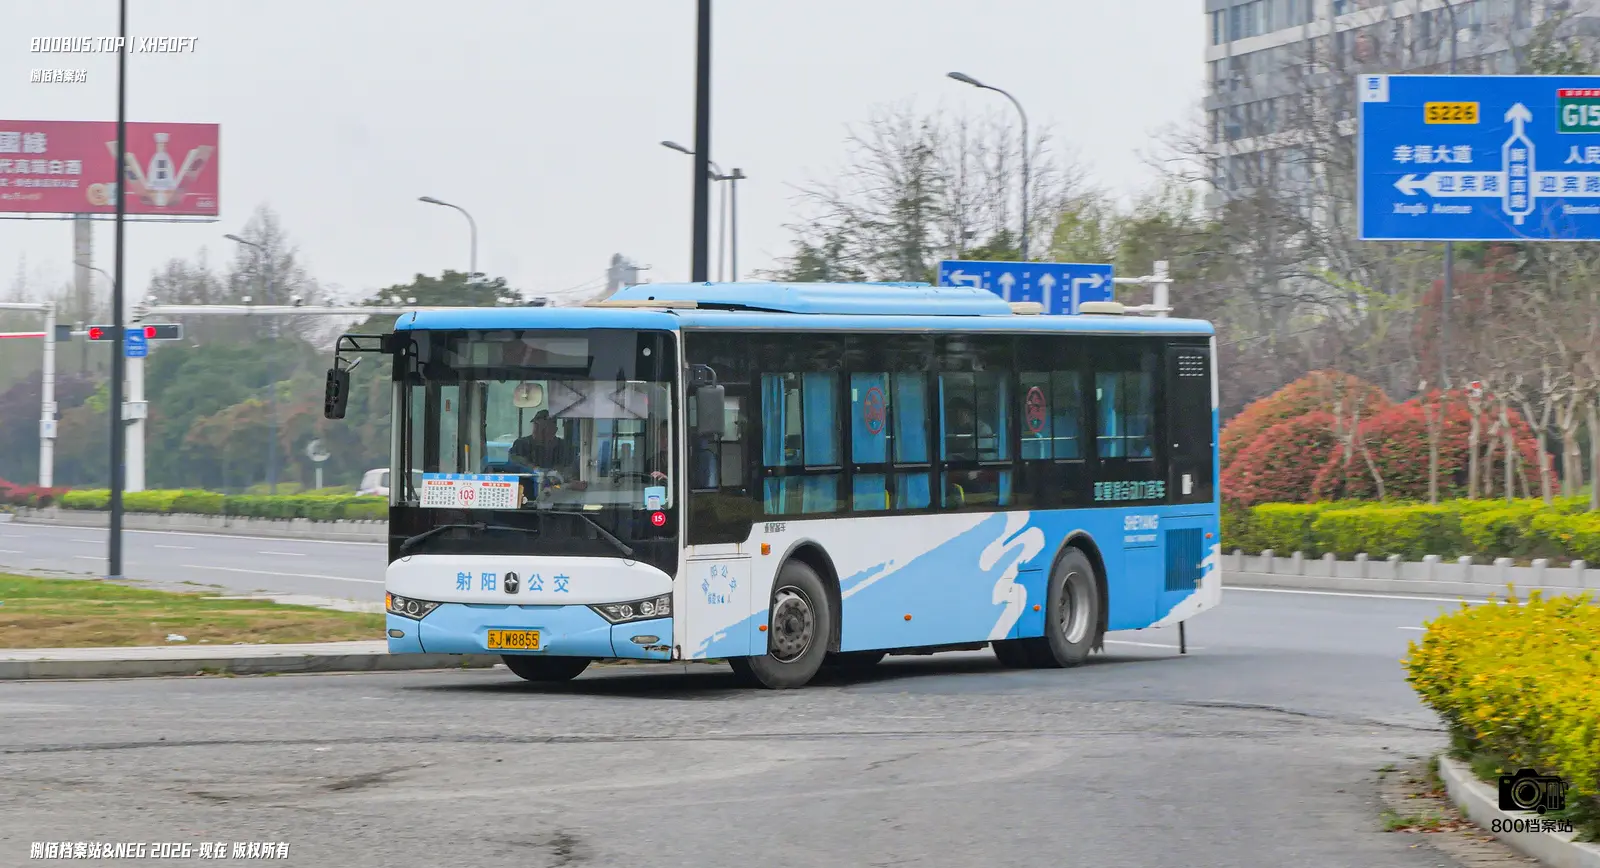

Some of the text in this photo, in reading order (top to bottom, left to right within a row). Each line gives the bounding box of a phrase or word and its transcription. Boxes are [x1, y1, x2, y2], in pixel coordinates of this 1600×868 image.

[1429, 105, 1475, 120] S226
[1562, 104, 1600, 126] G15
[1392, 144, 1473, 164] 幸福大道
[1437, 175, 1499, 192] 迎宾路
[1539, 175, 1600, 192] 迎宾路
[459, 489, 475, 501] 103
[654, 514, 663, 522] 15
[455, 571, 571, 593] 射阳 公交
